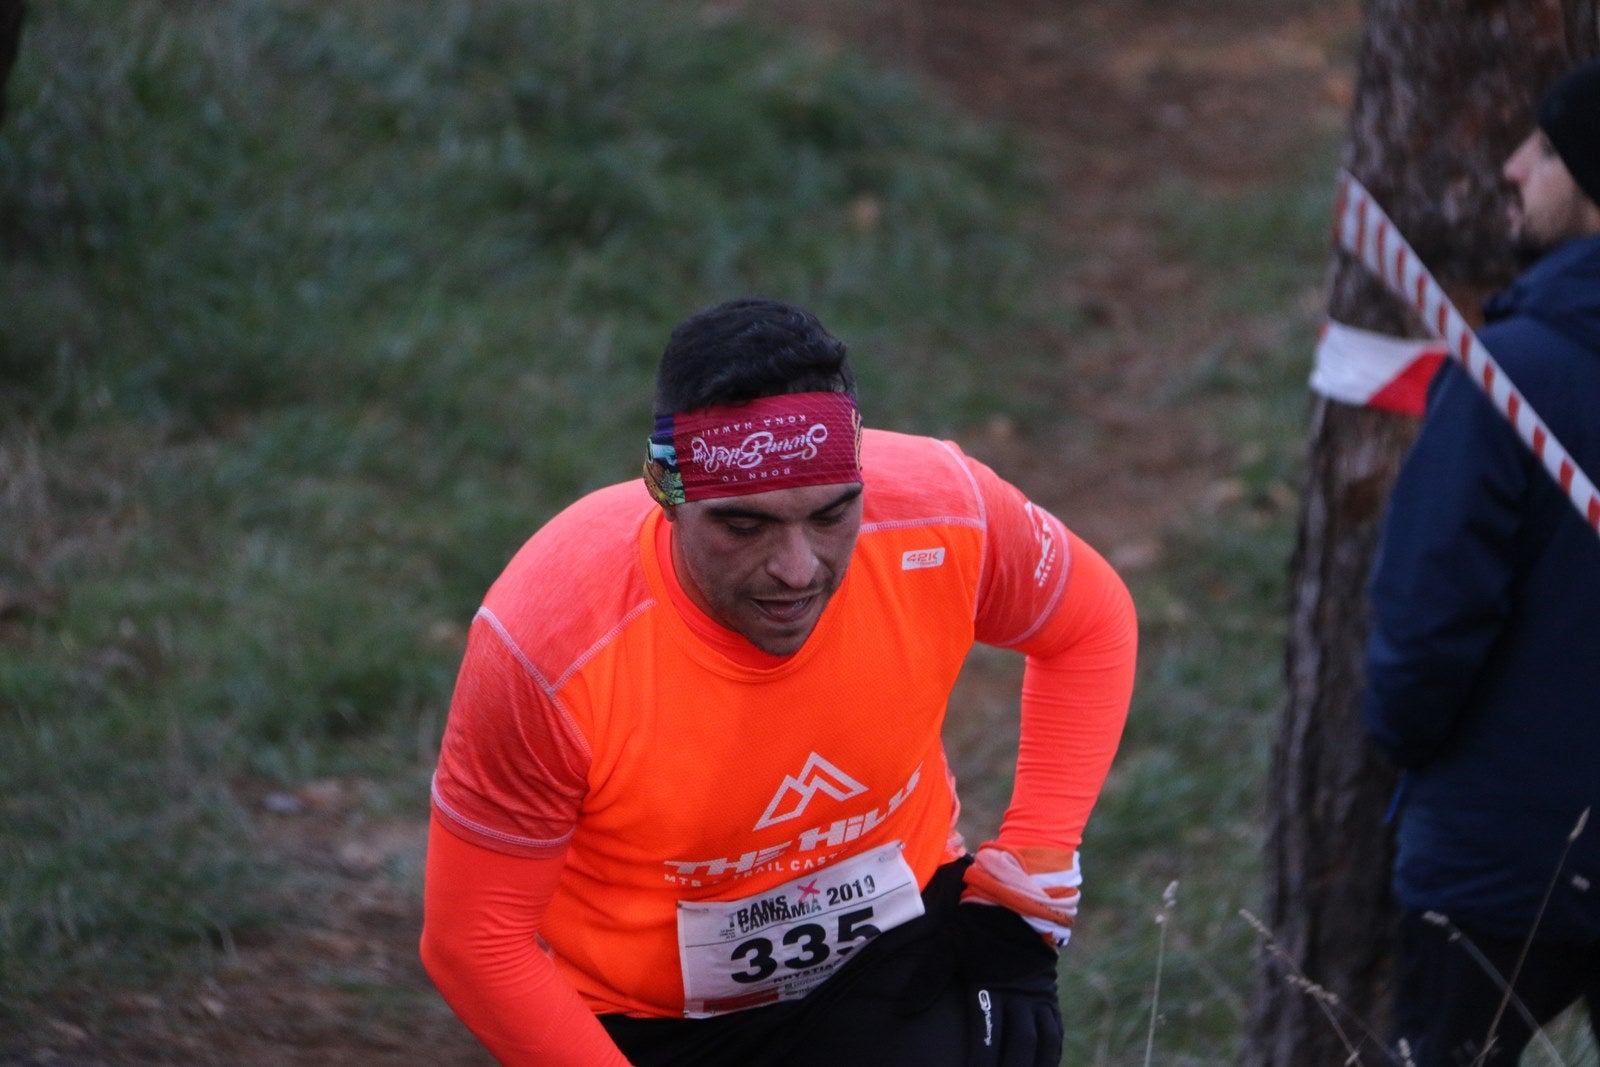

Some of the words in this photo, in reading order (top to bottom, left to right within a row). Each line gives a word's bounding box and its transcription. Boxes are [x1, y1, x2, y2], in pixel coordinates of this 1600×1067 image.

[763, 414, 807, 427] KONA
[701, 422, 752, 438] HAWAII
[749, 467, 791, 480] BORN
[906, 551, 938, 563] 42K
[663, 839, 793, 876] THE
[726, 894, 788, 929] TRANS
[826, 874, 876, 907] 2019
[730, 906, 882, 985] 335
